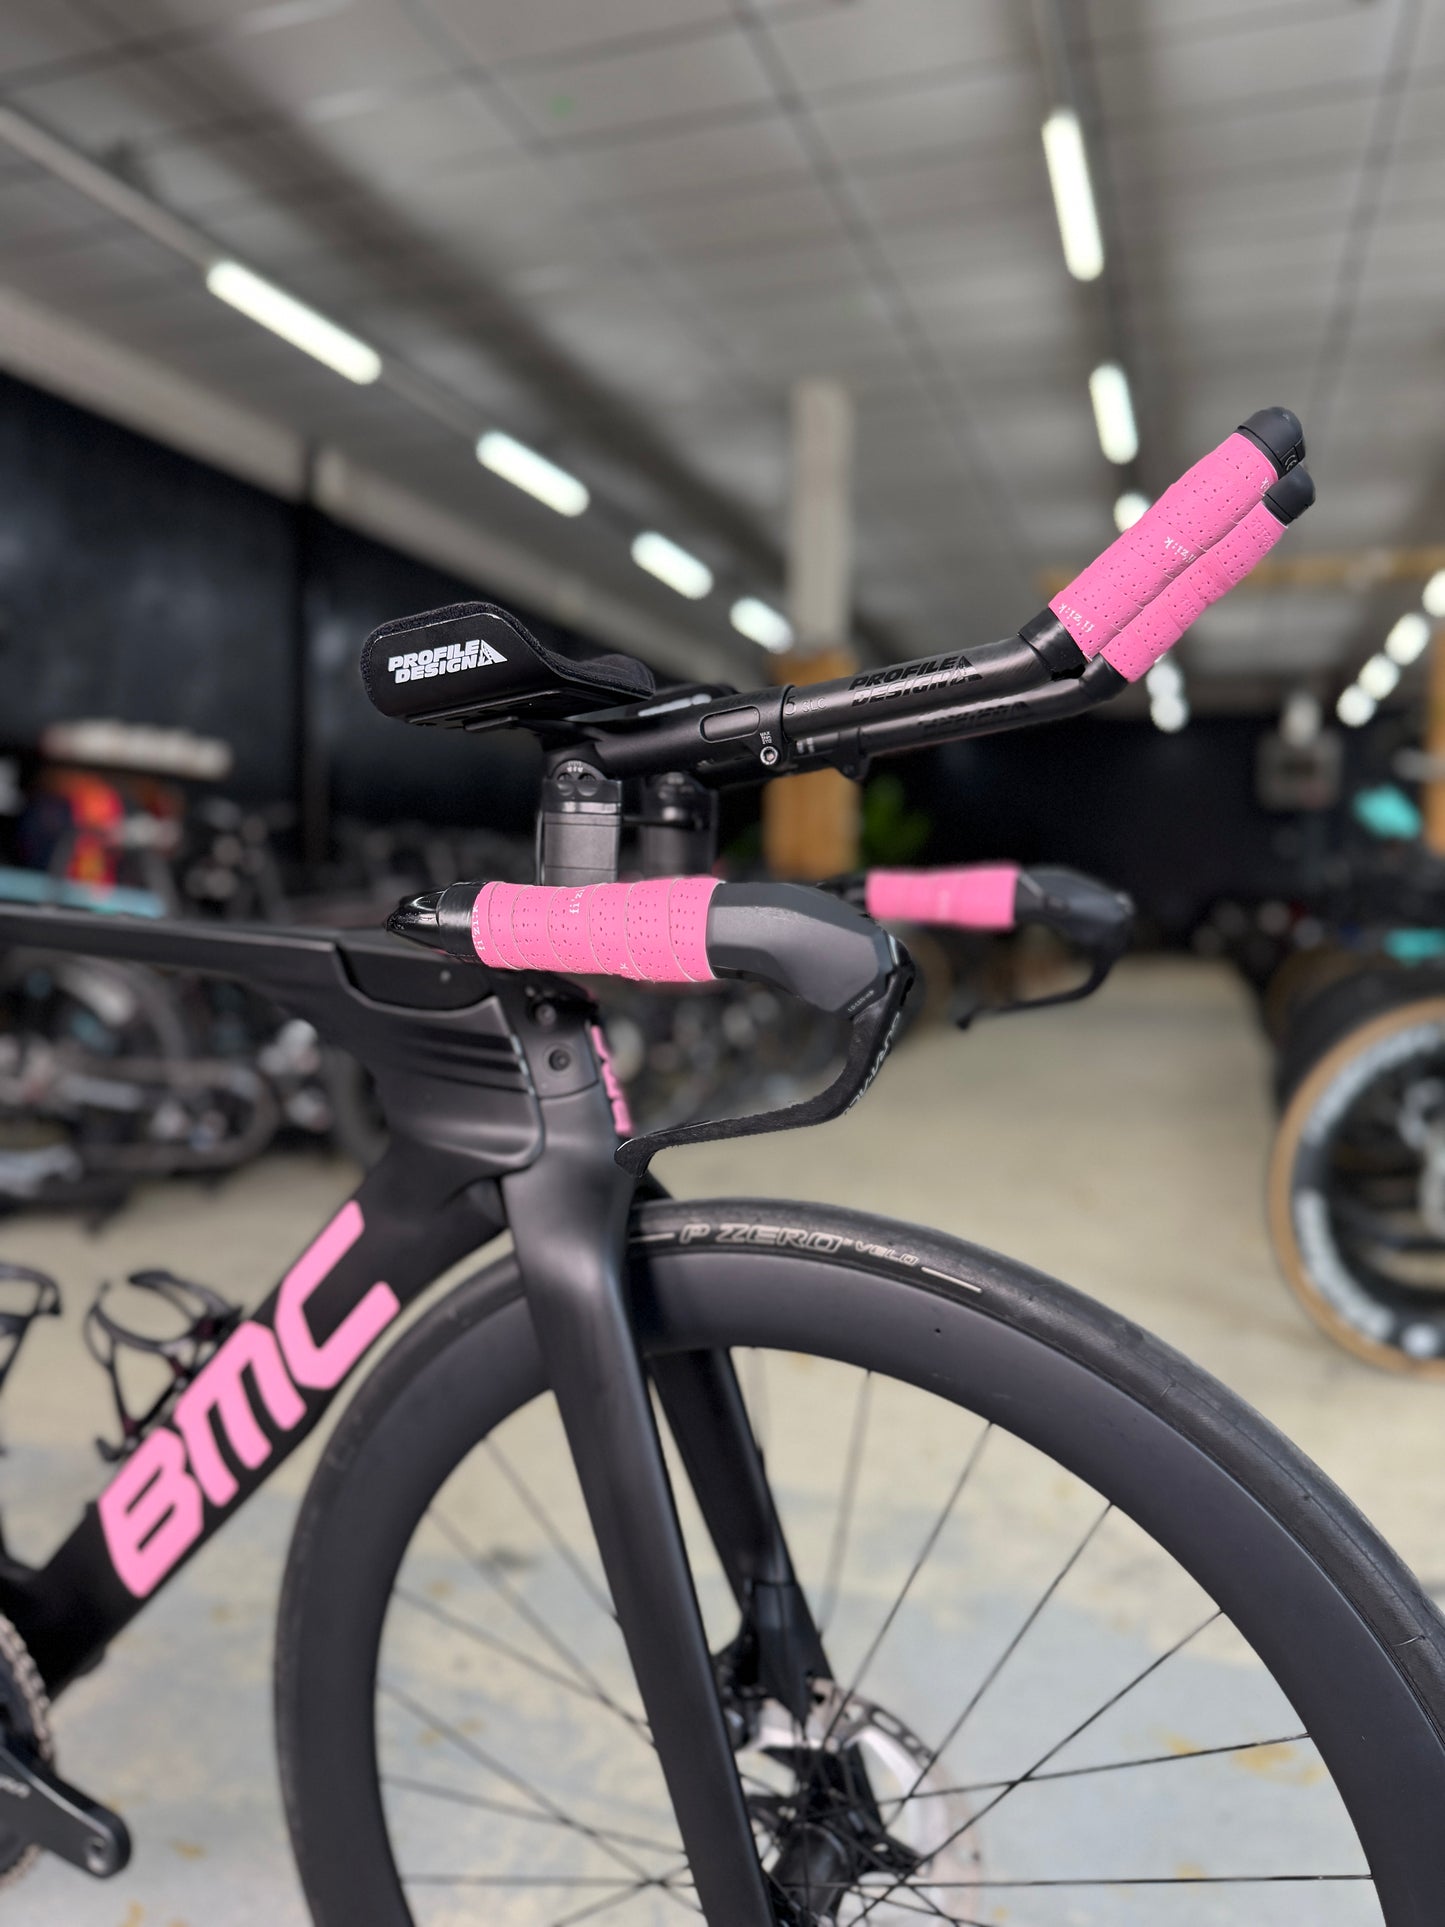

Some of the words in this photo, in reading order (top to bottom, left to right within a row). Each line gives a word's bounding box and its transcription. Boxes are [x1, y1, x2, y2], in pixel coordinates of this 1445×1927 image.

[388, 639, 480, 672] PROFILE
[394, 654, 478, 684] DESIGN
[848, 656, 960, 692] PROFILE
[851, 668, 957, 707] DESIGN
[680, 1223, 710, 1244] P
[716, 1223, 844, 1254] ZERO
[855, 1240, 919, 1266] VELO
[97, 1200, 400, 1598] BMC
